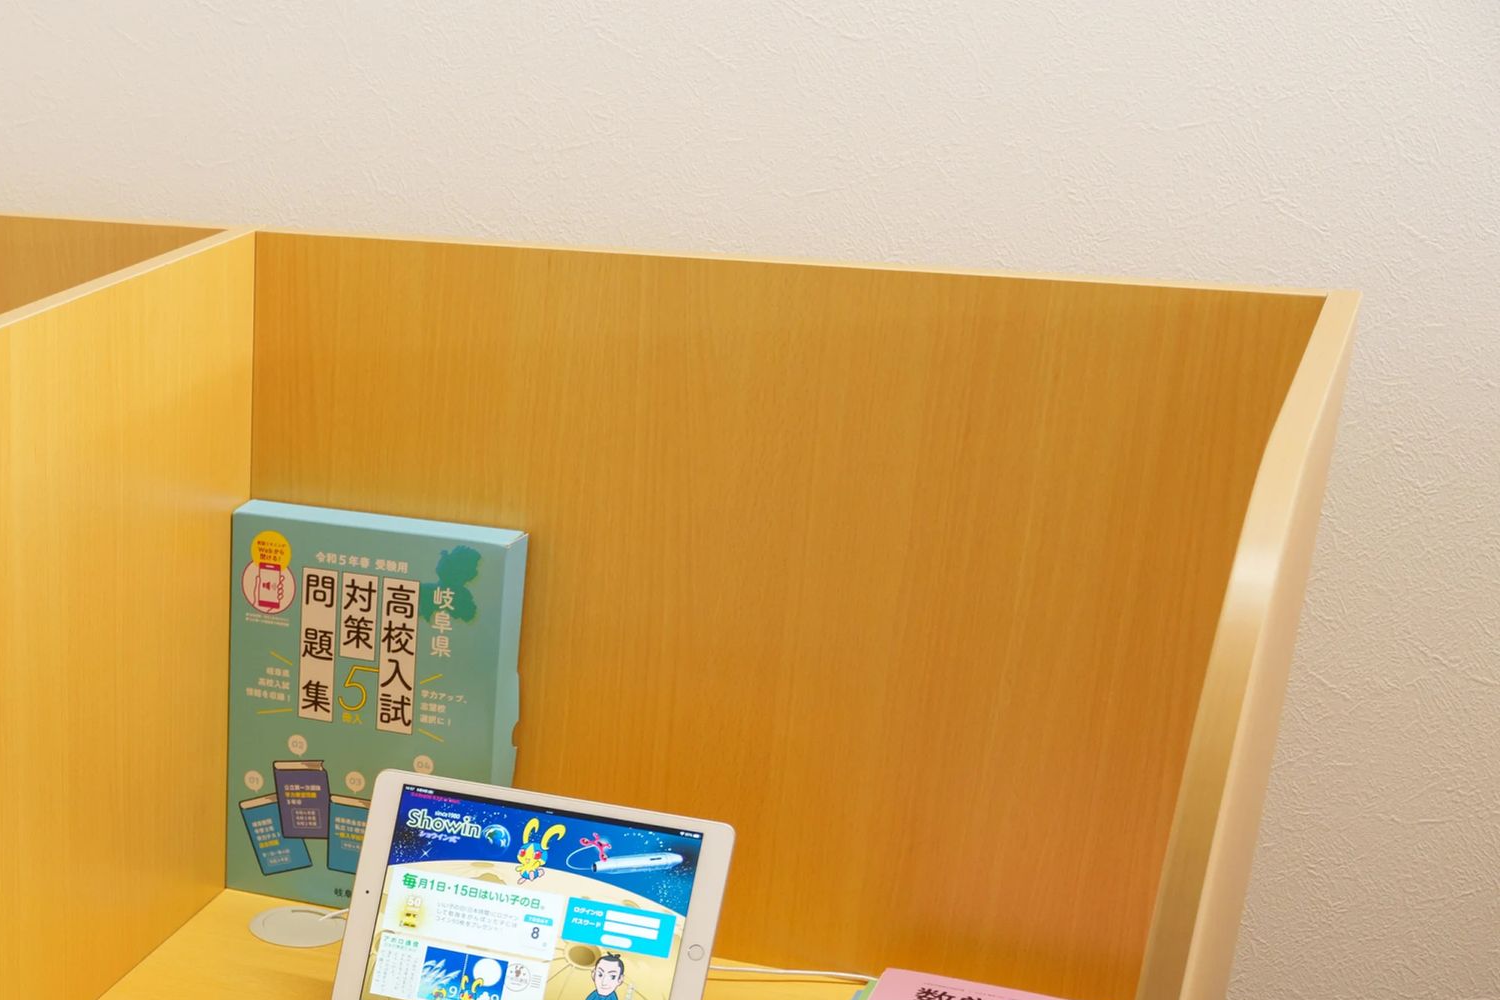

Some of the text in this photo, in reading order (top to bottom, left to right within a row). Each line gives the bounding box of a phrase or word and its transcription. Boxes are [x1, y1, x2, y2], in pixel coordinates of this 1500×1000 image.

[316, 551, 408, 574] 令和5年春 受験用
[343, 579, 376, 649] 対策
[430, 587, 455, 658] 岐阜県
[301, 574, 335, 714] 問題集
[380, 585, 416, 727] 高校入試
[338, 665, 379, 711] 5
[248, 777, 259, 786] 01
[406, 808, 481, 838] Showin
[531, 927, 540, 939] 8
[571, 917, 601, 928] パスワード
[448, 985, 458, 998] 9
